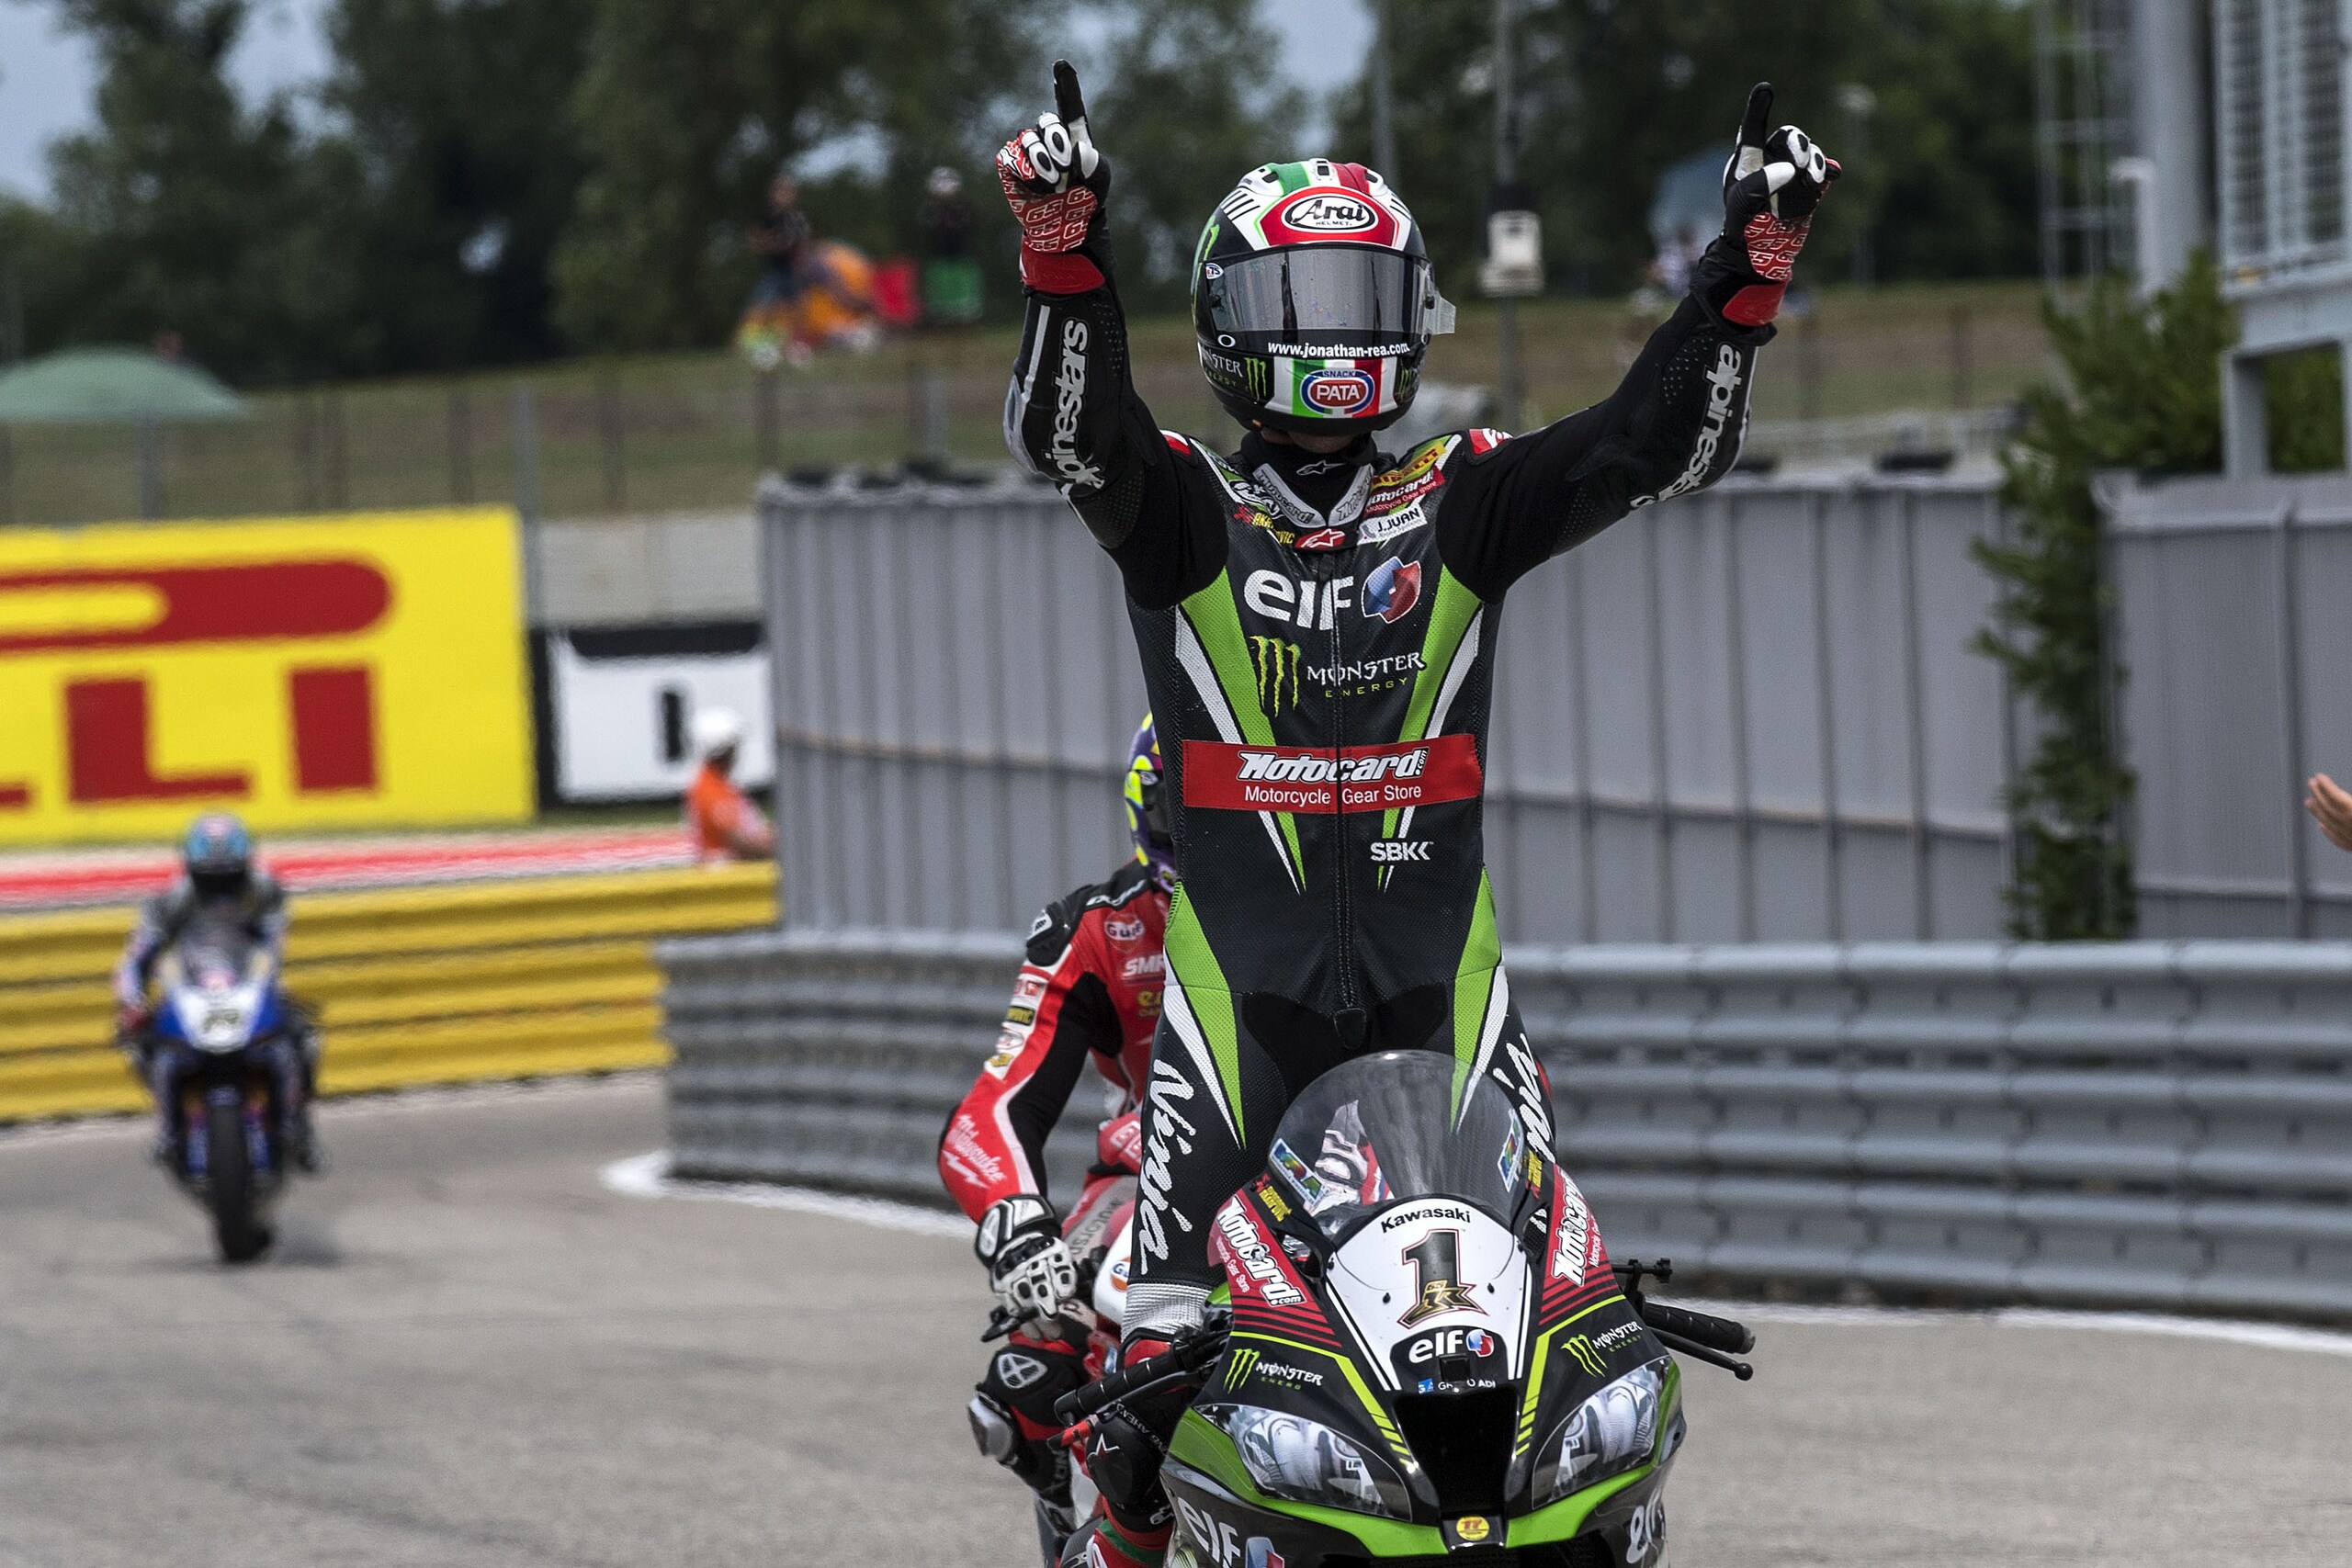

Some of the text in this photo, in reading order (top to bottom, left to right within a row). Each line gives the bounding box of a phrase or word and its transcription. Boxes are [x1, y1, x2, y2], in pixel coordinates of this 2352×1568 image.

[1291, 199, 1366, 226] Arai
[1268, 342, 1410, 358] www.jonathan-rea.com
[1323, 369, 1355, 378] SNACK
[1316, 384, 1360, 400] PATA
[1377, 507, 1420, 533] J.JUAN
[1244, 570, 1354, 631] elf
[1307, 652, 1425, 686] MONSTER
[1326, 677, 1408, 698] ENERGY
[1245, 784, 1422, 807] Motorcycle Gear Store
[1381, 1208, 1471, 1234] Kawasaki
[1397, 1228, 1489, 1329] 1
[1408, 1330, 1464, 1364] elf
[1592, 1321, 1643, 1349] MONSTER
[1256, 1361, 1323, 1386] MONSTER
